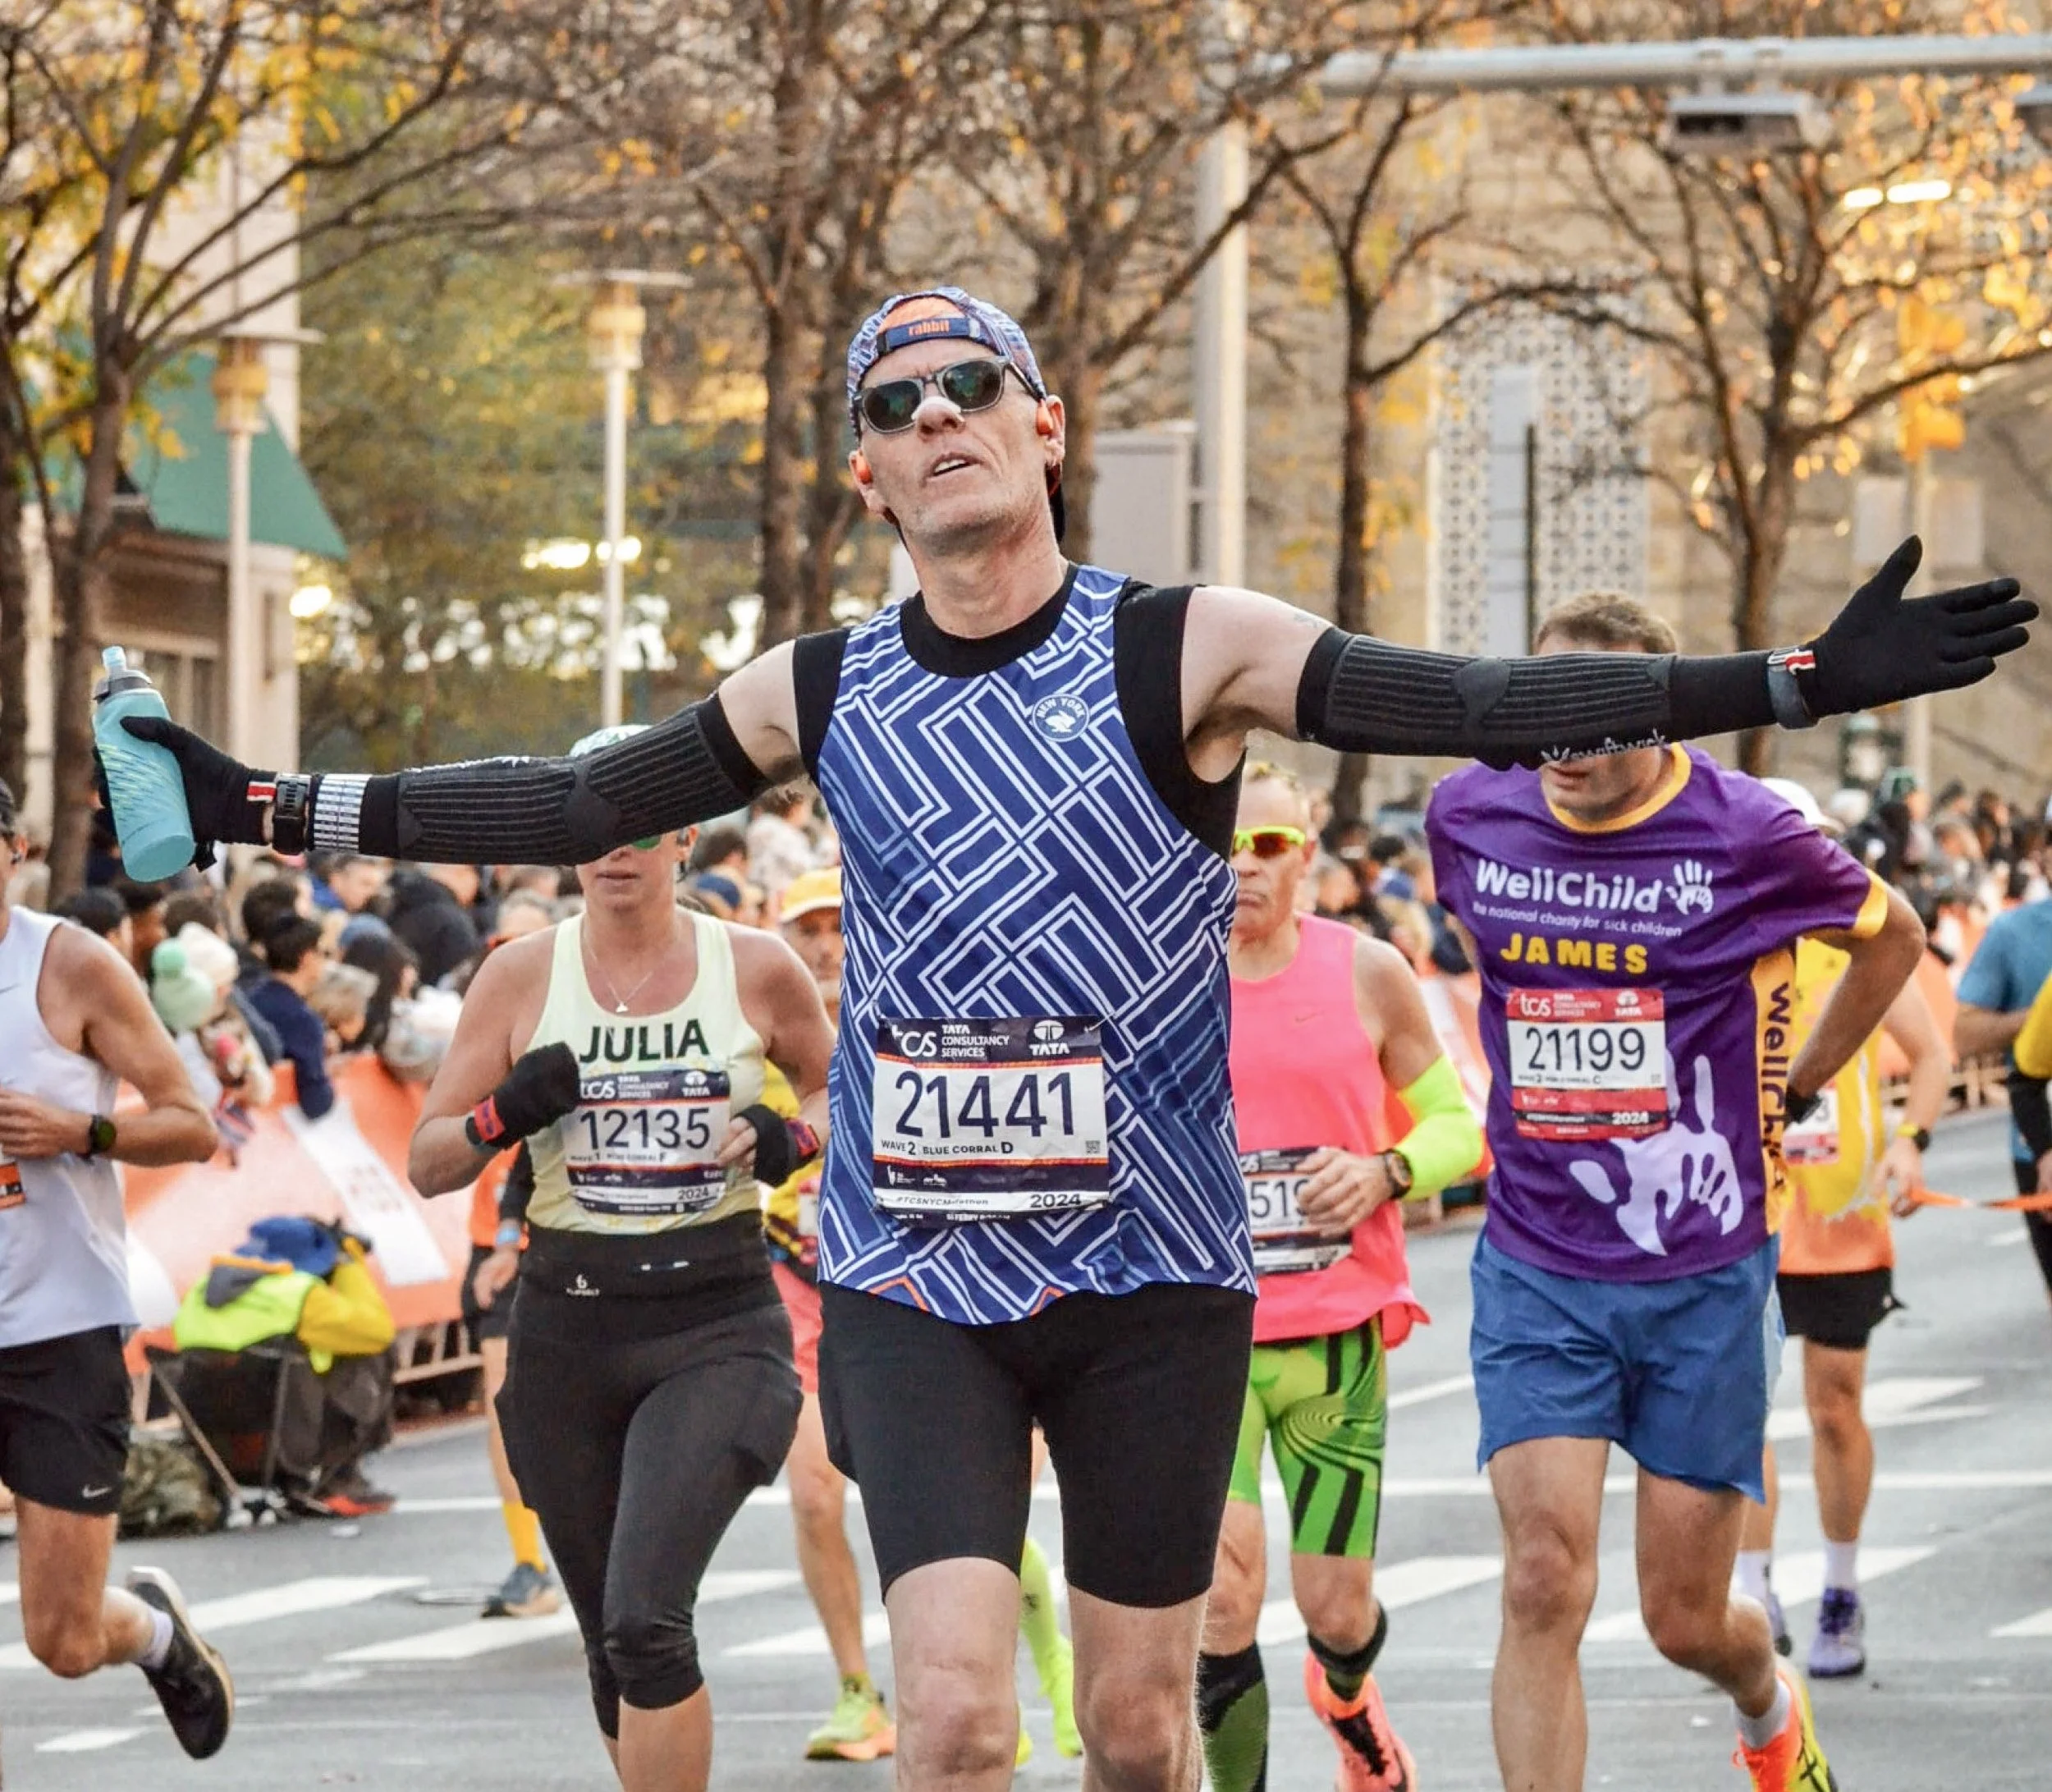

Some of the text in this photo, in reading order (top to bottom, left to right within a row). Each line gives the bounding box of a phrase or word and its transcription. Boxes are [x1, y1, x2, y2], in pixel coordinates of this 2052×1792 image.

[1476, 859, 1663, 914] WellChild
[1488, 905, 1538, 922] national
[1539, 912, 1582, 930] charity
[1583, 914, 1600, 929] for
[1603, 919, 1628, 933] sick
[1631, 920, 1683, 937] children
[1500, 933, 1647, 974] JAMES
[579, 1019, 709, 1063] JULIA
[941, 1024, 970, 1034] TATA
[941, 1035, 1010, 1047] CONSULTANCY
[941, 1047, 985, 1057] SERVICES
[1029, 1043, 1070, 1056] TATA
[1526, 1027, 1646, 1071] 21199
[895, 1070, 1074, 1139] 21441
[580, 1108, 710, 1150] 12135
[882, 1139, 1014, 1155] WAVE 2 BLUE CORRAL D
[678, 1187, 709, 1200] 2024
[1029, 1194, 1082, 1208] 2024
